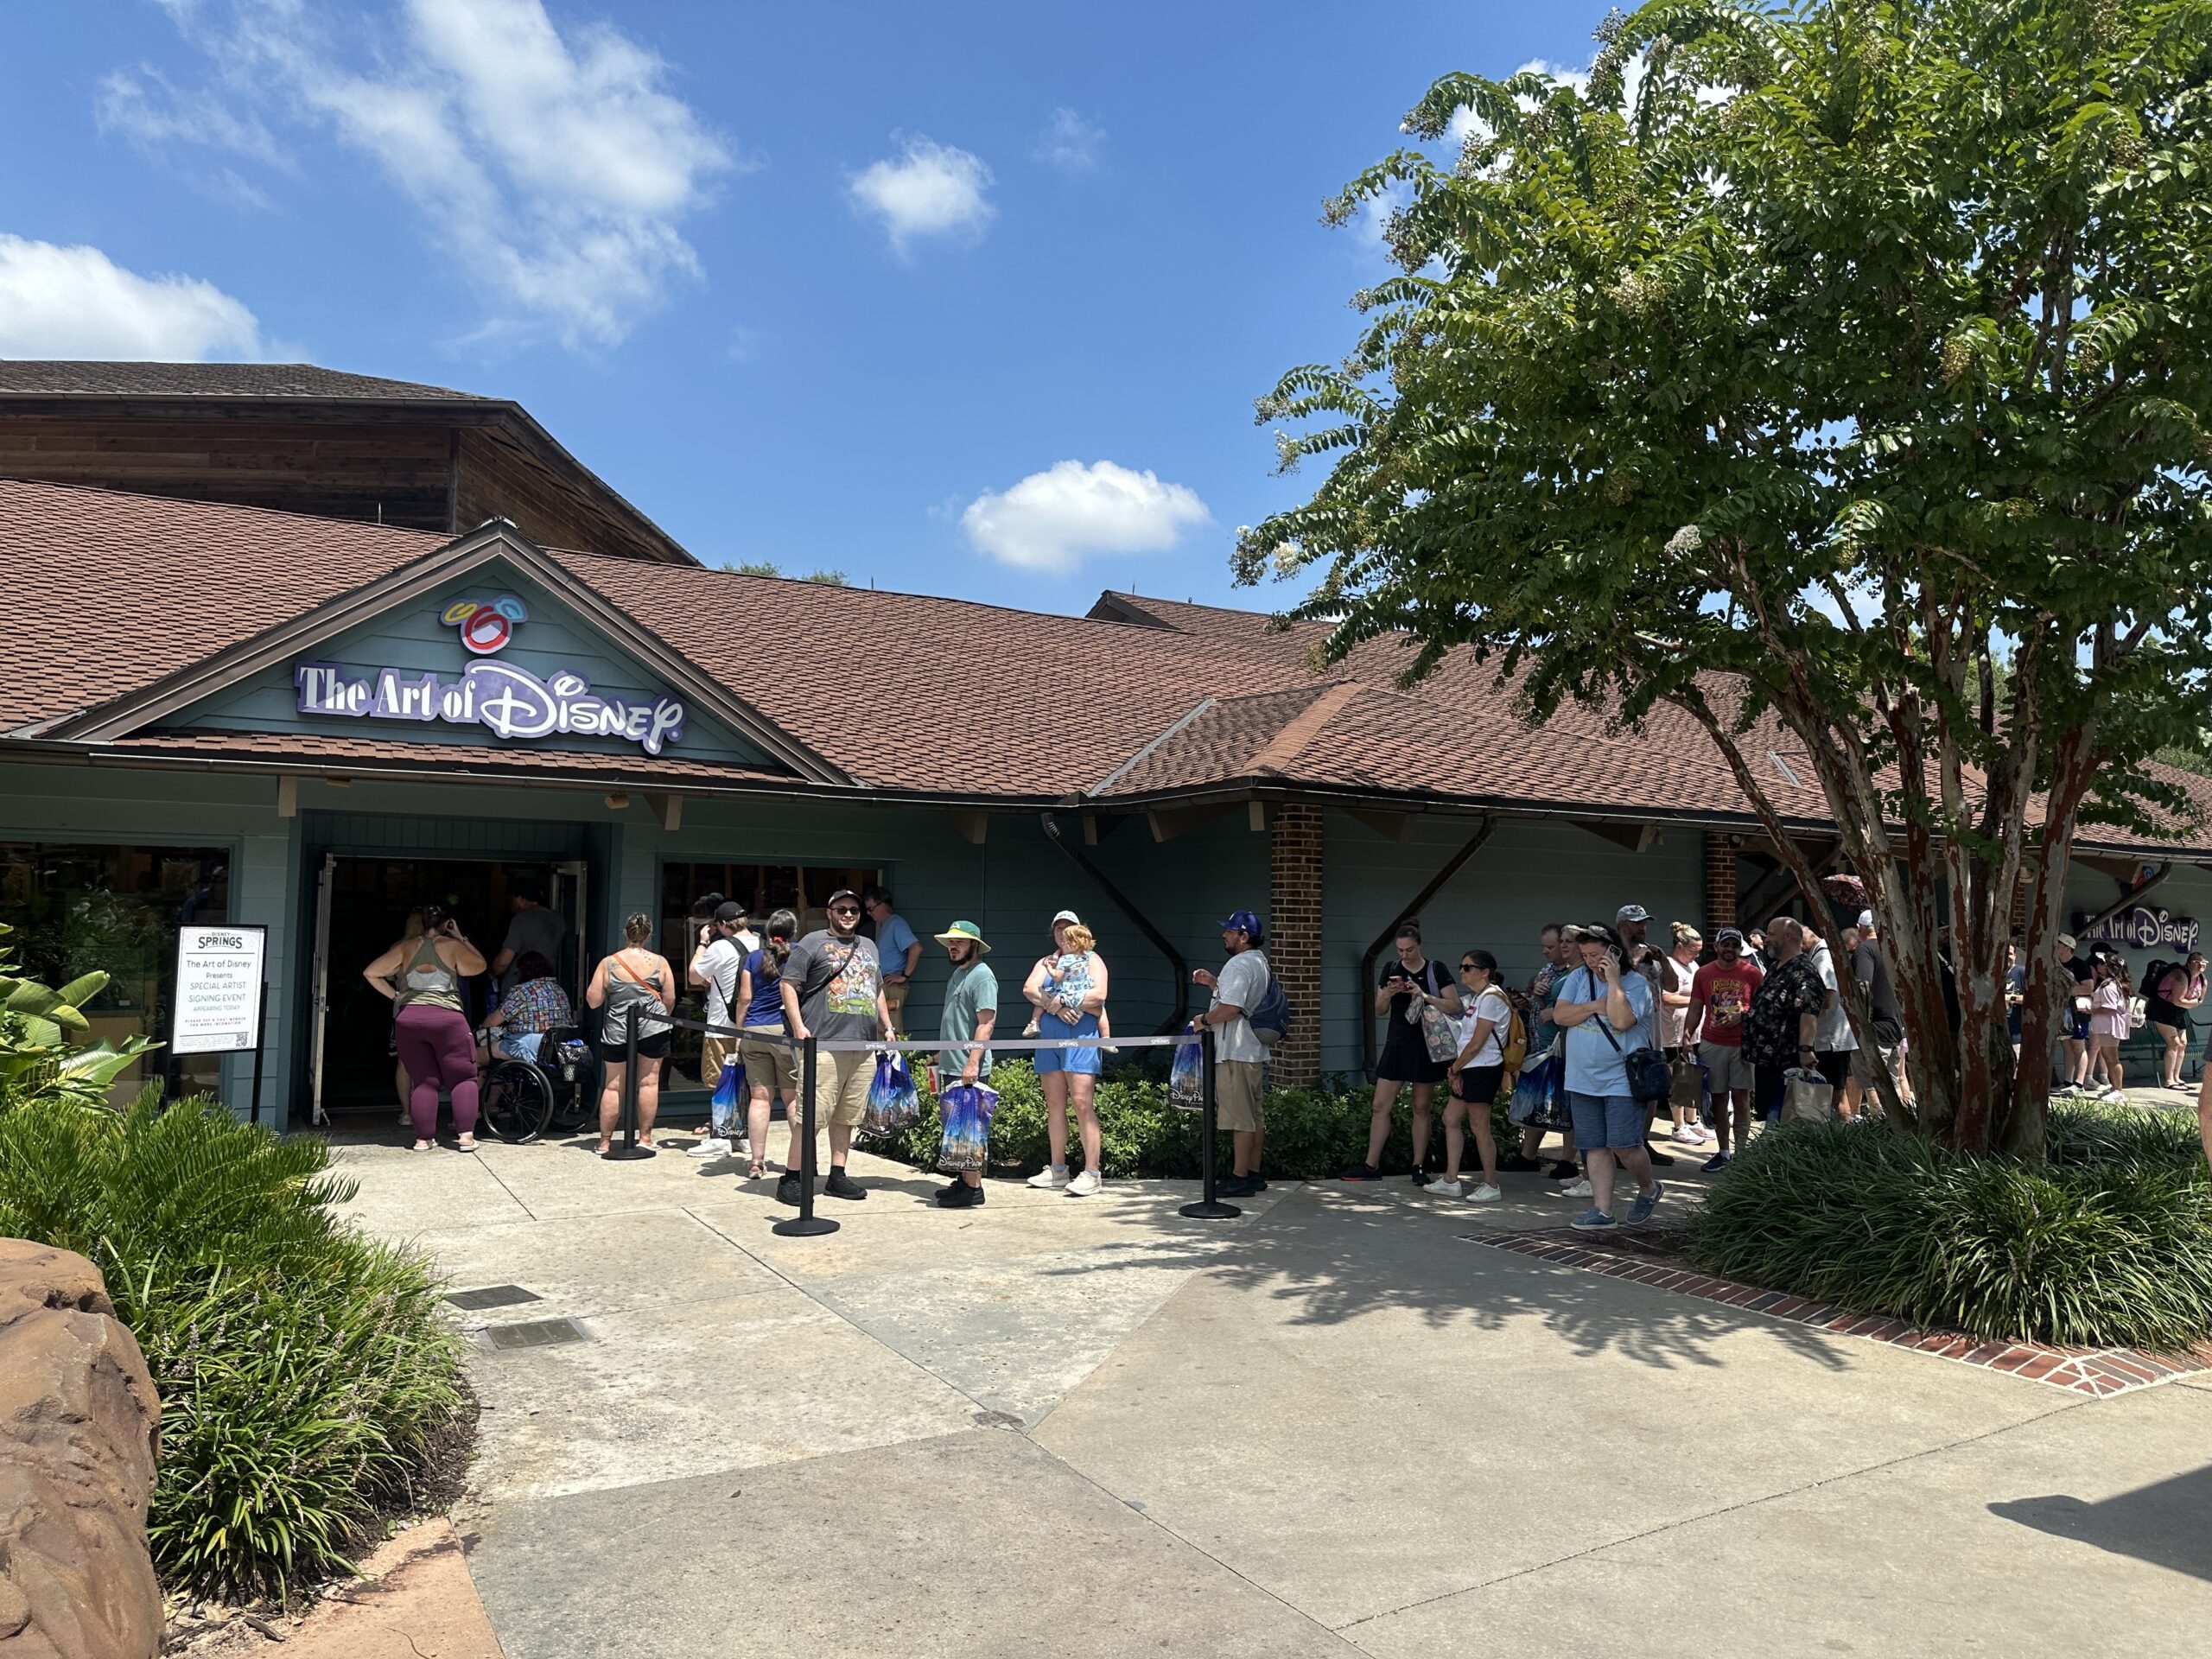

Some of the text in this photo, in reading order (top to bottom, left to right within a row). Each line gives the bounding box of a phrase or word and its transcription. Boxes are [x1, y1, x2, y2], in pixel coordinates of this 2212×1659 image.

[300, 666, 366, 710] The
[378, 674, 433, 715] Art
[443, 680, 476, 720] of
[2107, 916, 2124, 939] Art
[2126, 917, 2137, 939] of
[198, 936, 243, 950] SPRINGS
[227, 960, 251, 969] Disney
[190, 981, 247, 990] SPECIAL ARTIST
[188, 994, 246, 1003] SIGNING EVENT
